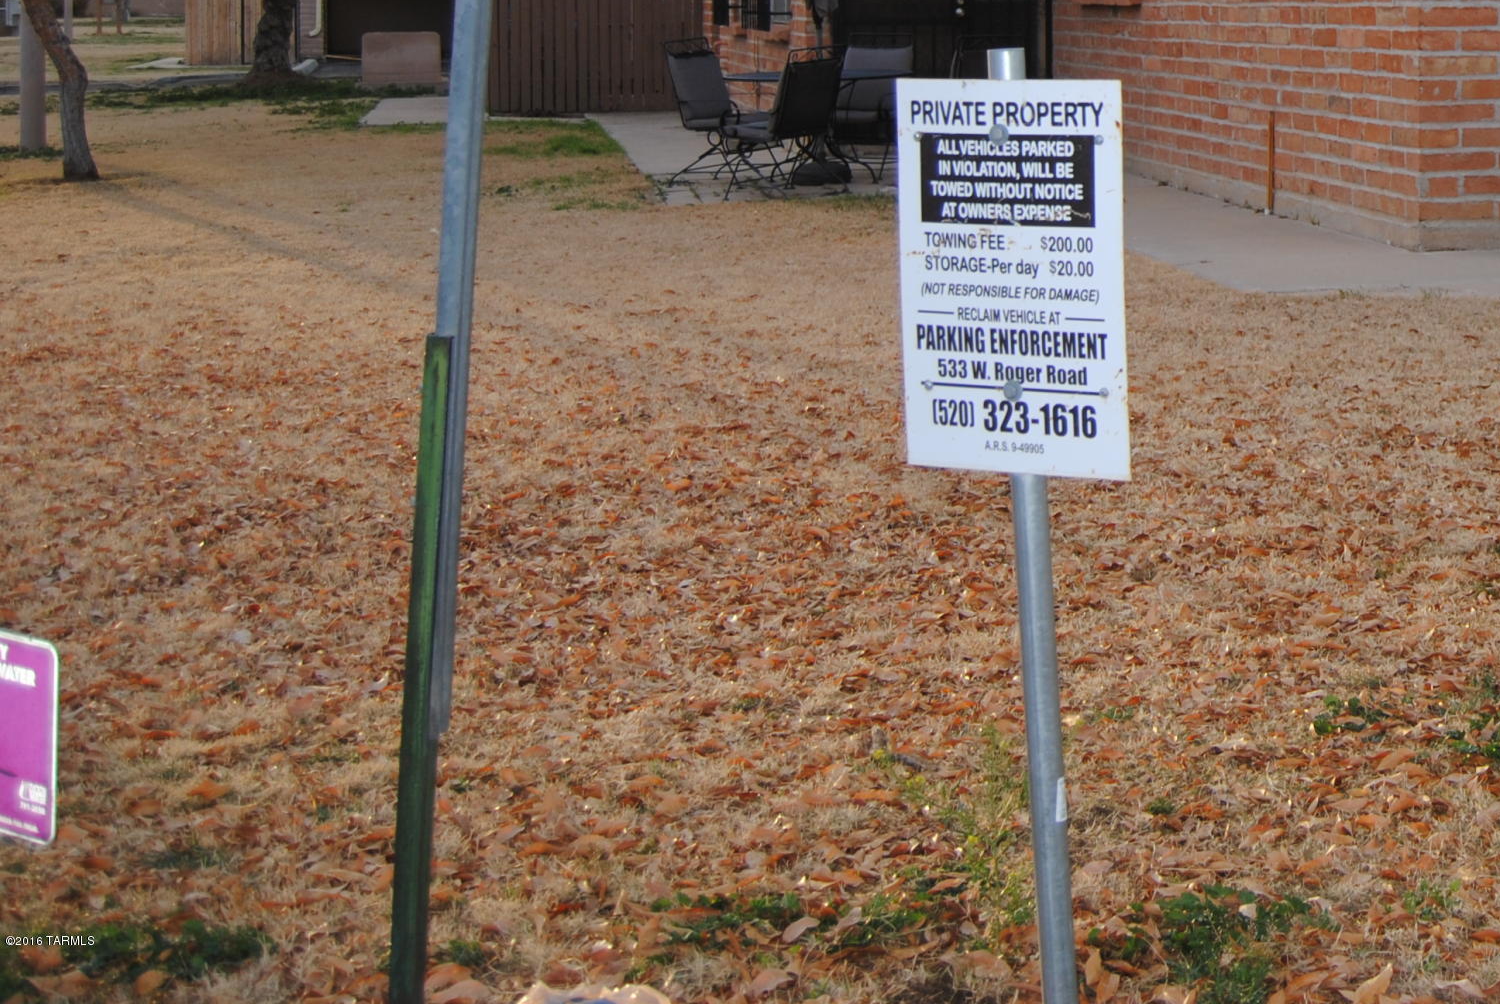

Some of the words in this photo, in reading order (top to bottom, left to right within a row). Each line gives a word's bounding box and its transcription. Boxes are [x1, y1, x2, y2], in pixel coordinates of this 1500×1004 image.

[910, 100, 986, 126] PRIVATE
[992, 101, 1103, 128] PROPERTY
[937, 139, 959, 155] ALL
[960, 140, 1019, 157] VEHICLES
[1019, 141, 1075, 157] PARKED
[938, 160, 951, 176] IN
[952, 161, 1020, 180] VIOLATION,
[1021, 162, 1054, 178] WILL
[1055, 163, 1074, 179] BE
[930, 181, 973, 197] TOWED
[974, 182, 1033, 199] WITHOUT
[1034, 184, 1084, 200] NOTICE
[941, 202, 957, 218] AT
[958, 203, 1012, 220] OWNERS
[1013, 204, 1072, 222] EXPENSE
[924, 231, 977, 249] TOWING
[980, 234, 1005, 250] FEE
[1040, 236, 1094, 253] $200.00
[925, 255, 1013, 275] STORAGE-Per
[1016, 259, 1039, 279] day
[1049, 260, 1094, 277] $20.00
[921, 282, 947, 297] (NOT
[948, 283, 1022, 300] RESPONSIBLE
[1023, 287, 1046, 301] FOR
[1048, 288, 1100, 305] DAMAGE)
[957, 307, 1001, 323] RECLAIM
[1002, 309, 1046, 324] VEHICLE
[1048, 311, 1061, 325] AT
[916, 324, 986, 354] PARKING
[990, 328, 1108, 360] ENFORCEMENT
[938, 358, 967, 379] 533
[971, 360, 991, 380] W.
[994, 362, 1042, 385] Roger
[1046, 365, 1088, 386] Road
[932, 398, 975, 427] (520)
[983, 399, 1097, 439] 323-1616
[984, 440, 1010, 452] A.R.S.
